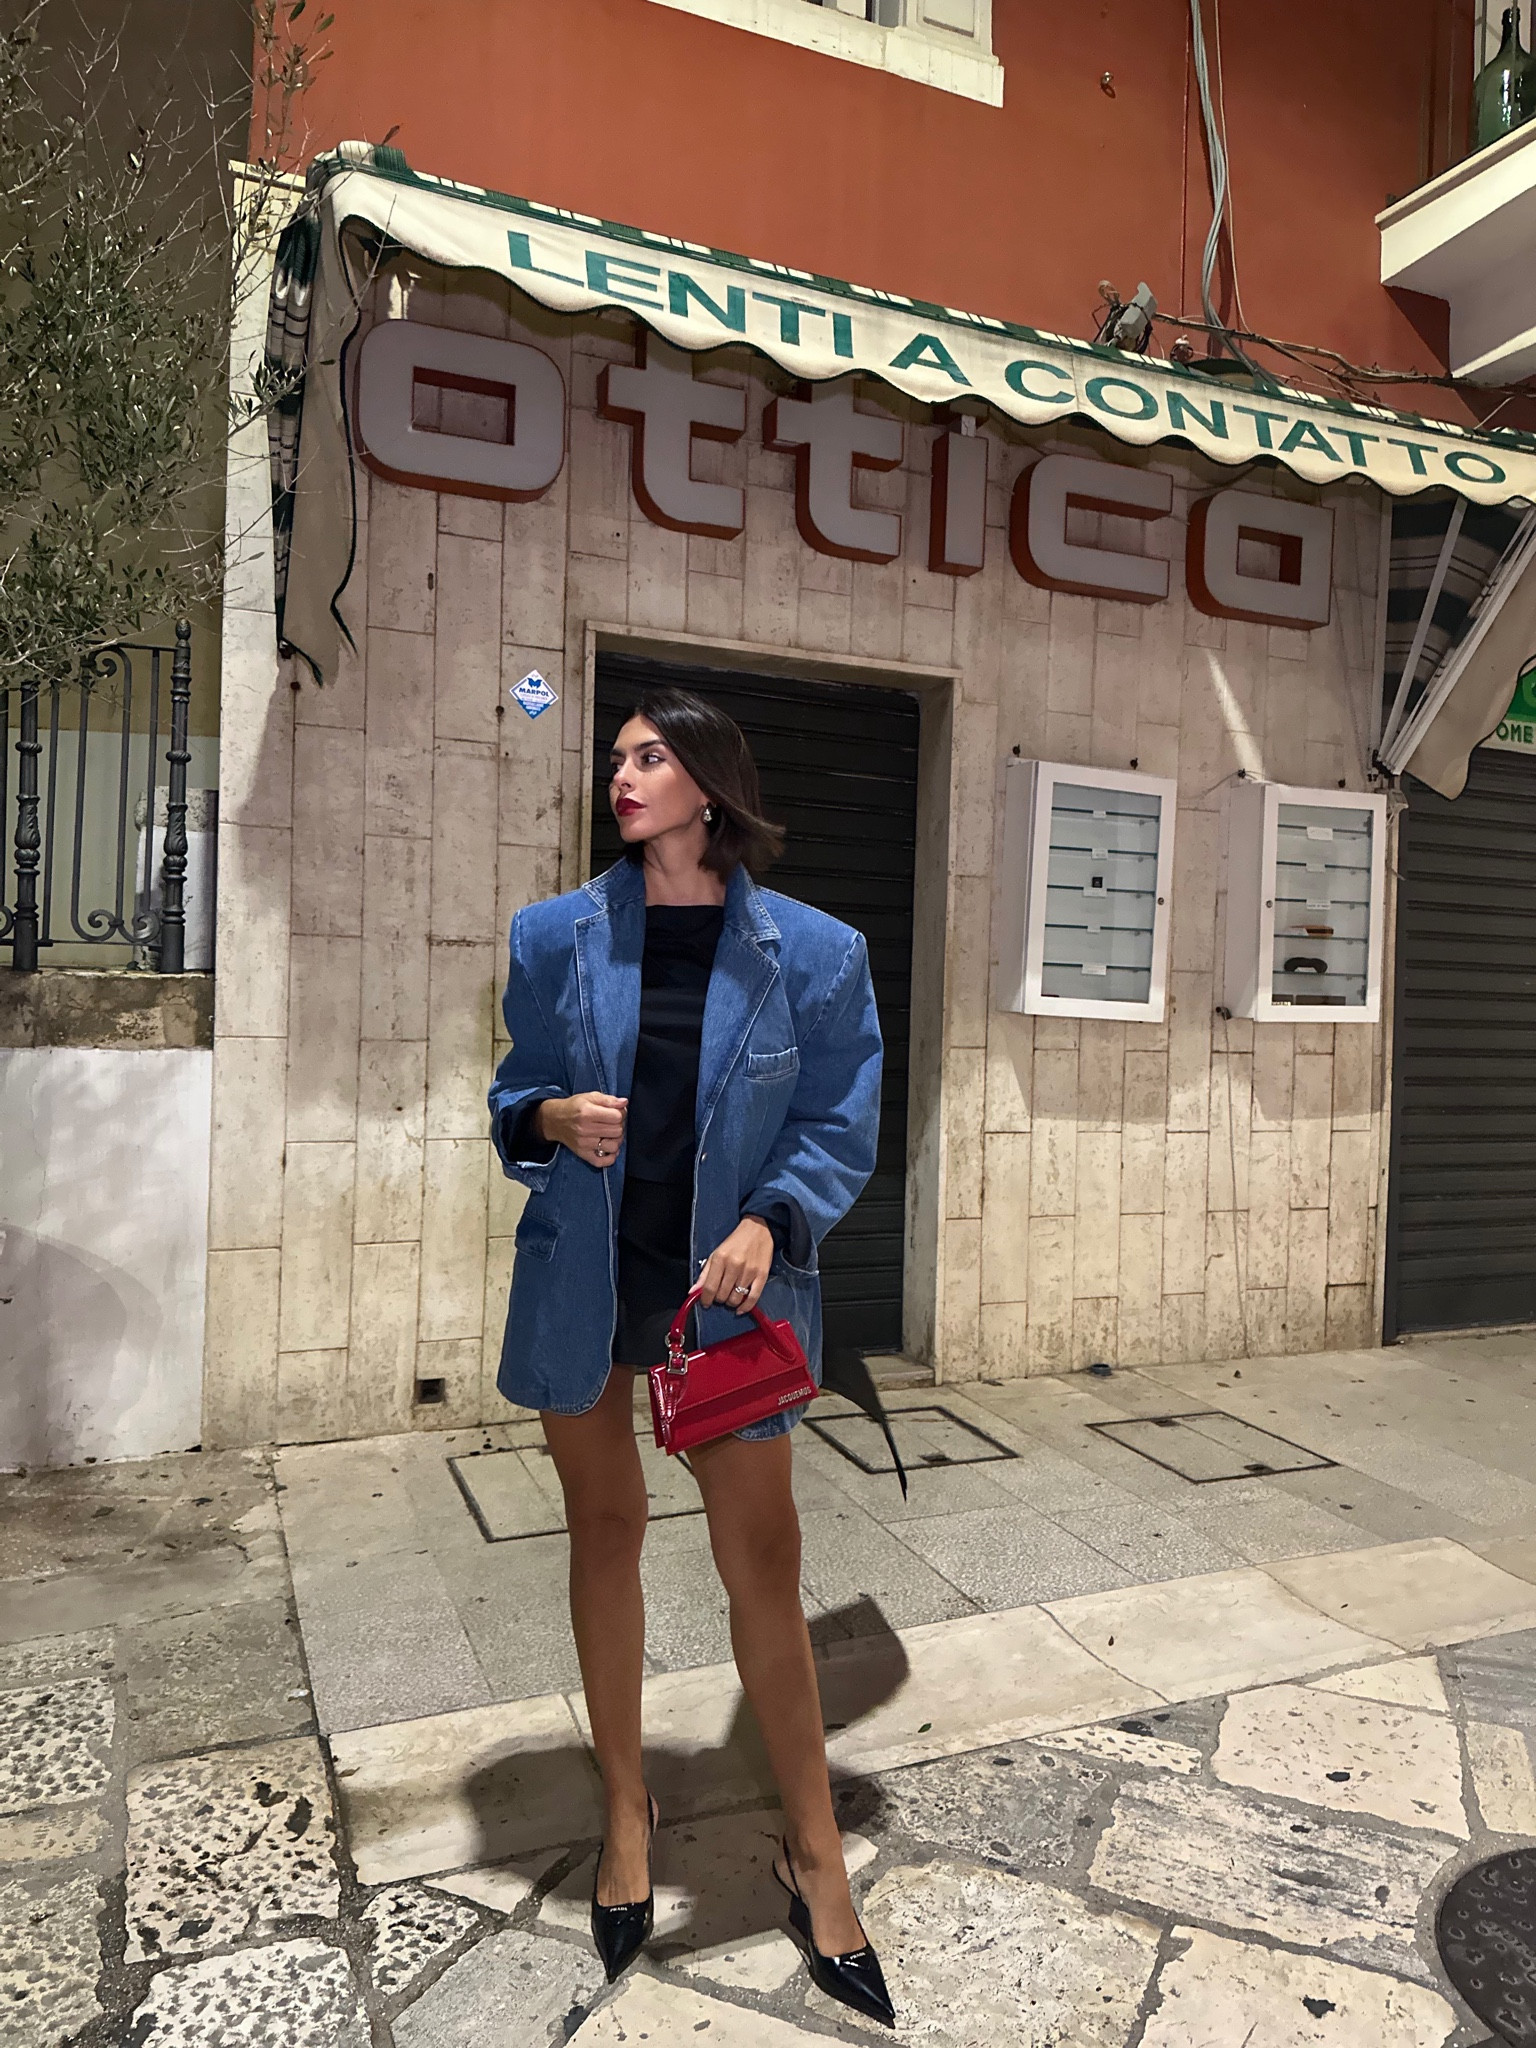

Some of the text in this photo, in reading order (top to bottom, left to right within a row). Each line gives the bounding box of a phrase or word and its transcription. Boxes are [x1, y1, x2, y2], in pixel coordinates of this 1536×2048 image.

[507, 230, 1507, 484] LENTI A CONTATTO
[519, 687, 549, 697] MARPOL
[777, 1386, 812, 1406] JACQUEMUS
